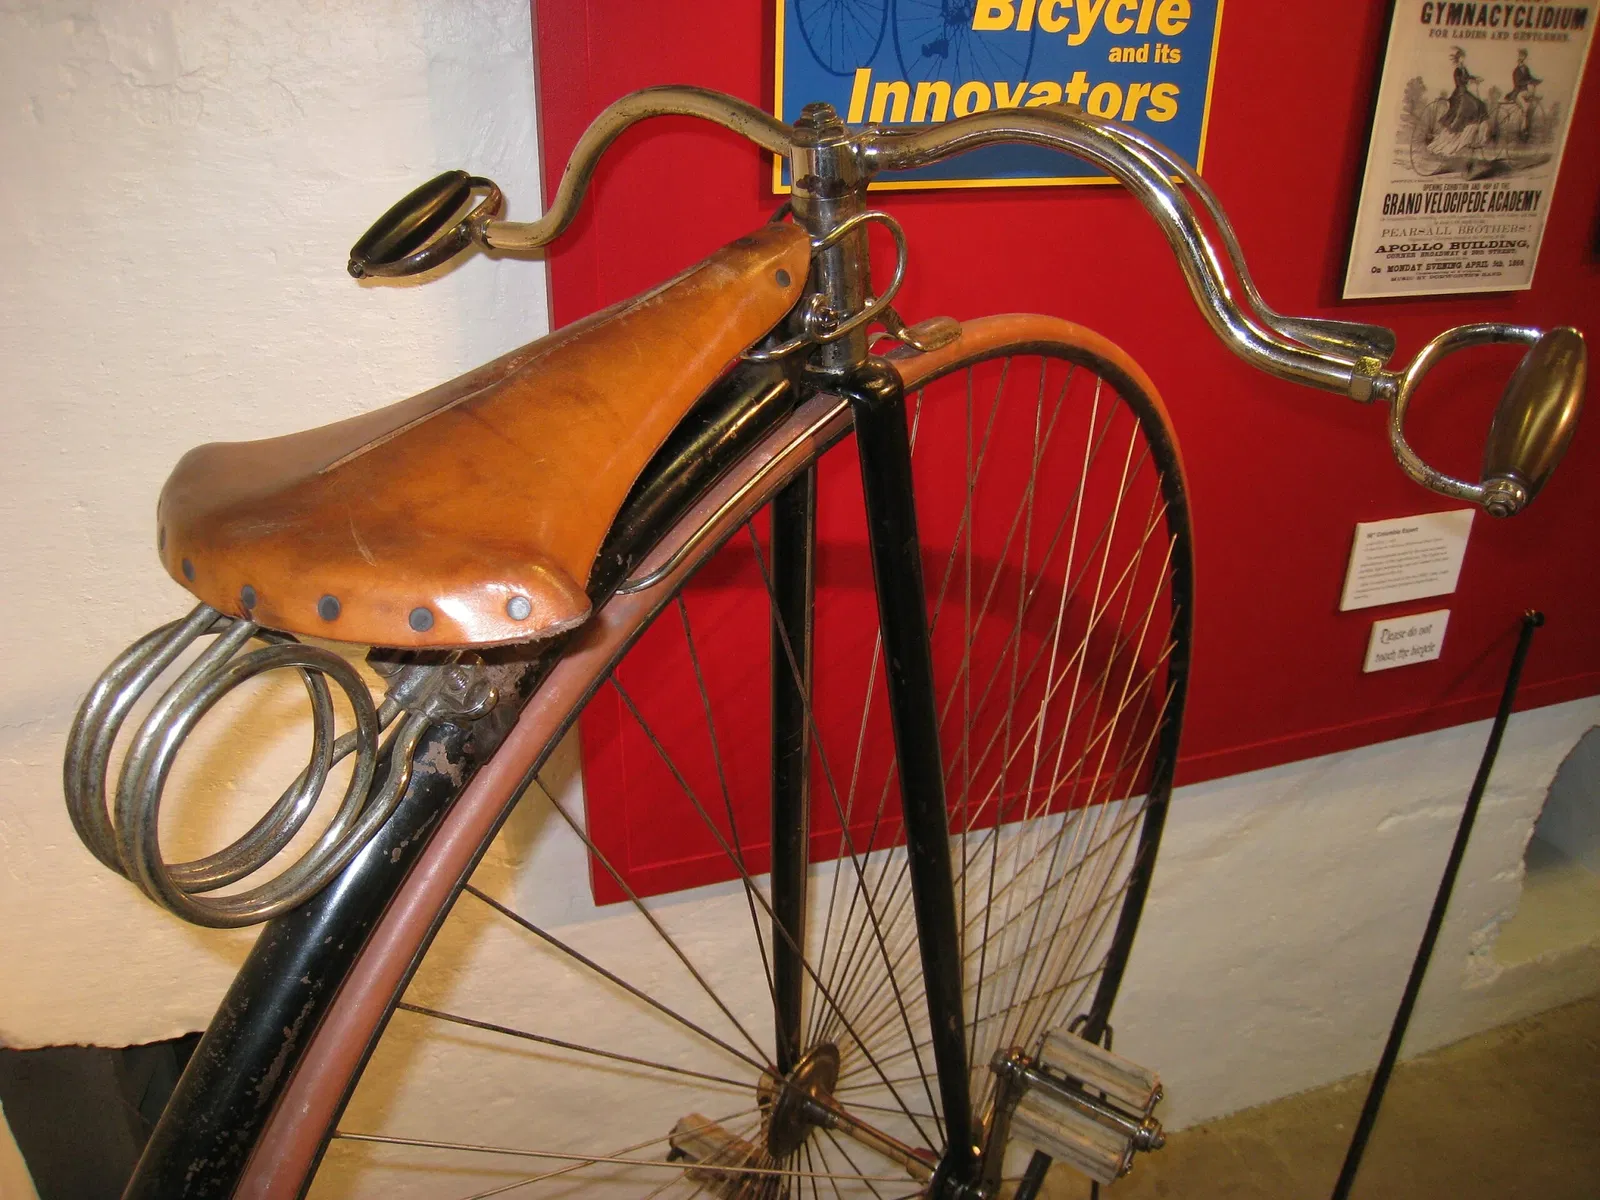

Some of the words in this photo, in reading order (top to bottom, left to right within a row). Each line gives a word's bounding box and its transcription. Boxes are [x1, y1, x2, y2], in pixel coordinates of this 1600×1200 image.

[971, 0, 1192, 46] Bicycle
[1420, 2, 1589, 31] GYMNACYCLIDIUM
[1429, 28, 1448, 39] FOR
[1452, 29, 1487, 40] LADIES
[1490, 31, 1510, 41] AND
[1108, 44, 1148, 63] and
[1154, 44, 1182, 64] its
[846, 68, 1180, 123] Innovators
[1383, 193, 1423, 216] GRAND
[1424, 190, 1489, 214] VELOCIPEDE
[1488, 190, 1542, 212] ACADEMY
[1375, 242, 1443, 253] APOLLO
[1450, 240, 1530, 250] BUILDING,
[1420, 250, 1460, 258] BROADWAY
[1387, 263, 1423, 273] MONDAY
[1426, 261, 1462, 271] EVENING
[1465, 260, 1489, 269] APRIL
